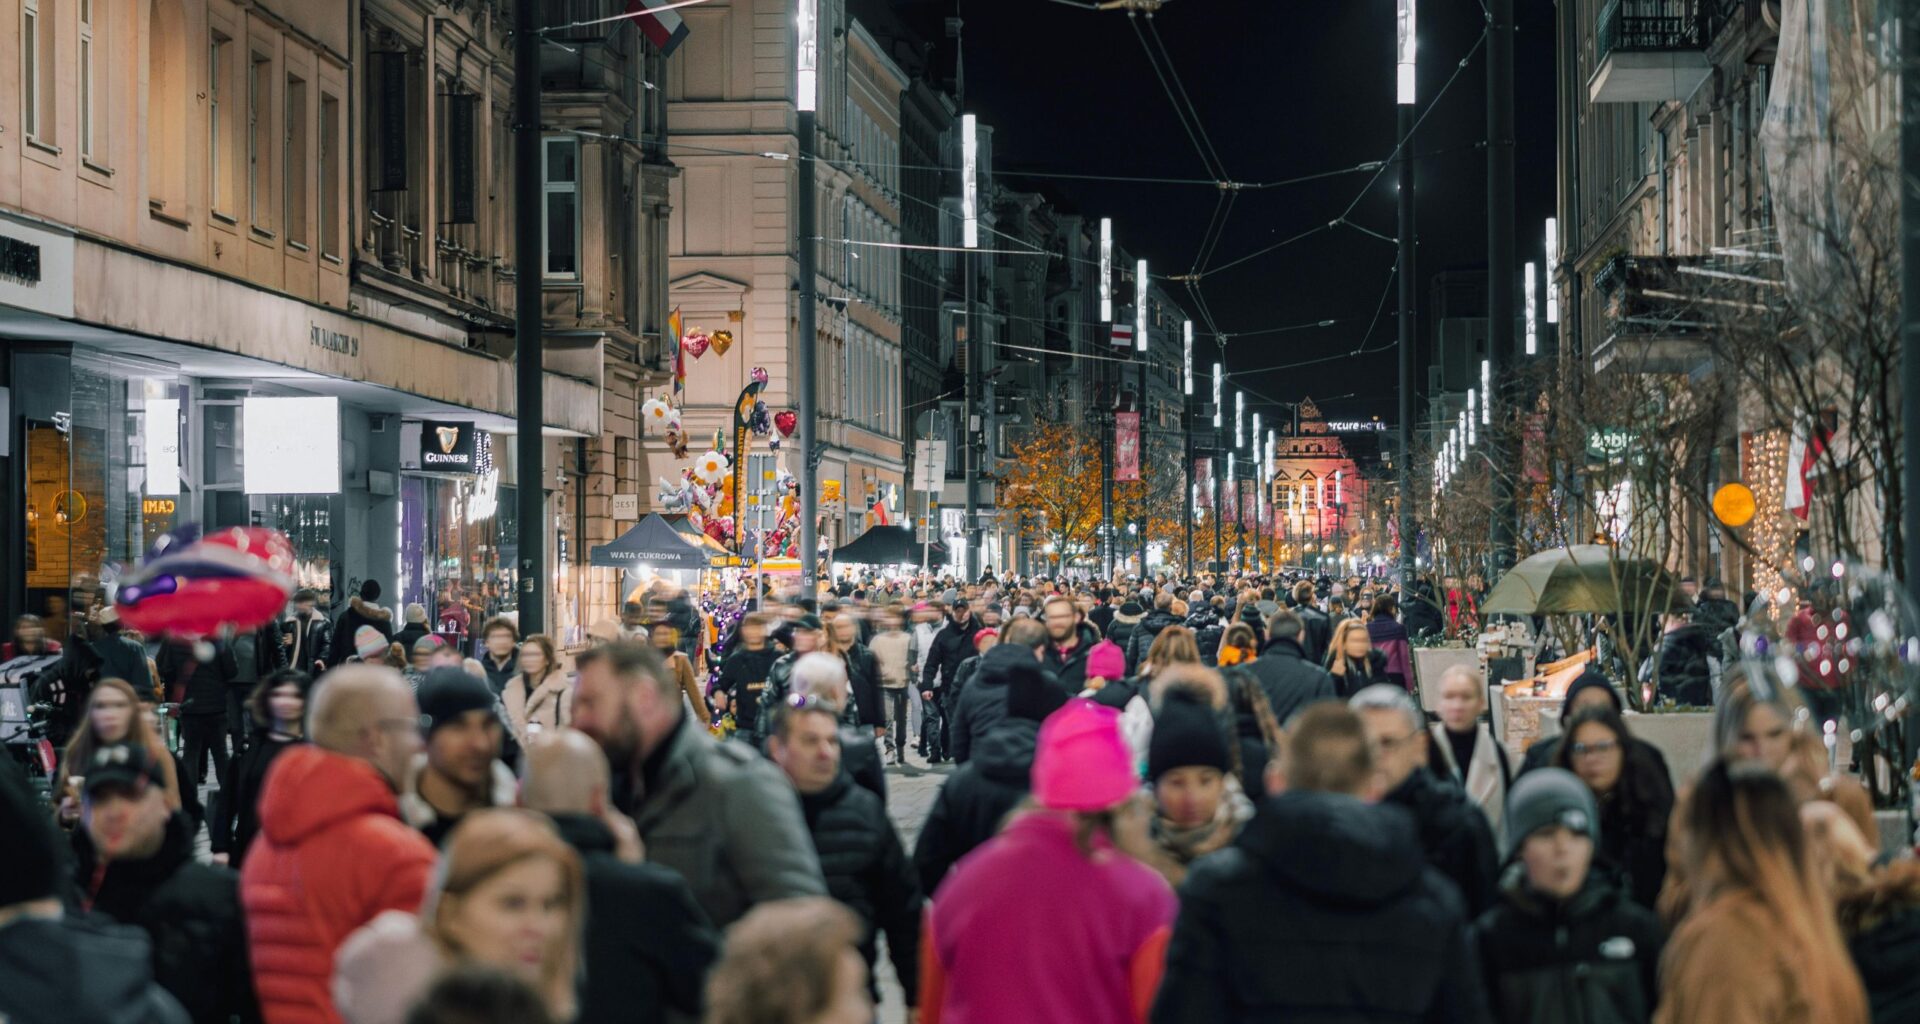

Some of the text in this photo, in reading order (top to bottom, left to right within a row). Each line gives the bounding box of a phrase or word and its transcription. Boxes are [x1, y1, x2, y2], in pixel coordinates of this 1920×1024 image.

[425, 452, 469, 463] GUINNESS
[614, 500, 635, 509] JEST
[610, 551, 682, 561] WATA CUKROWA
